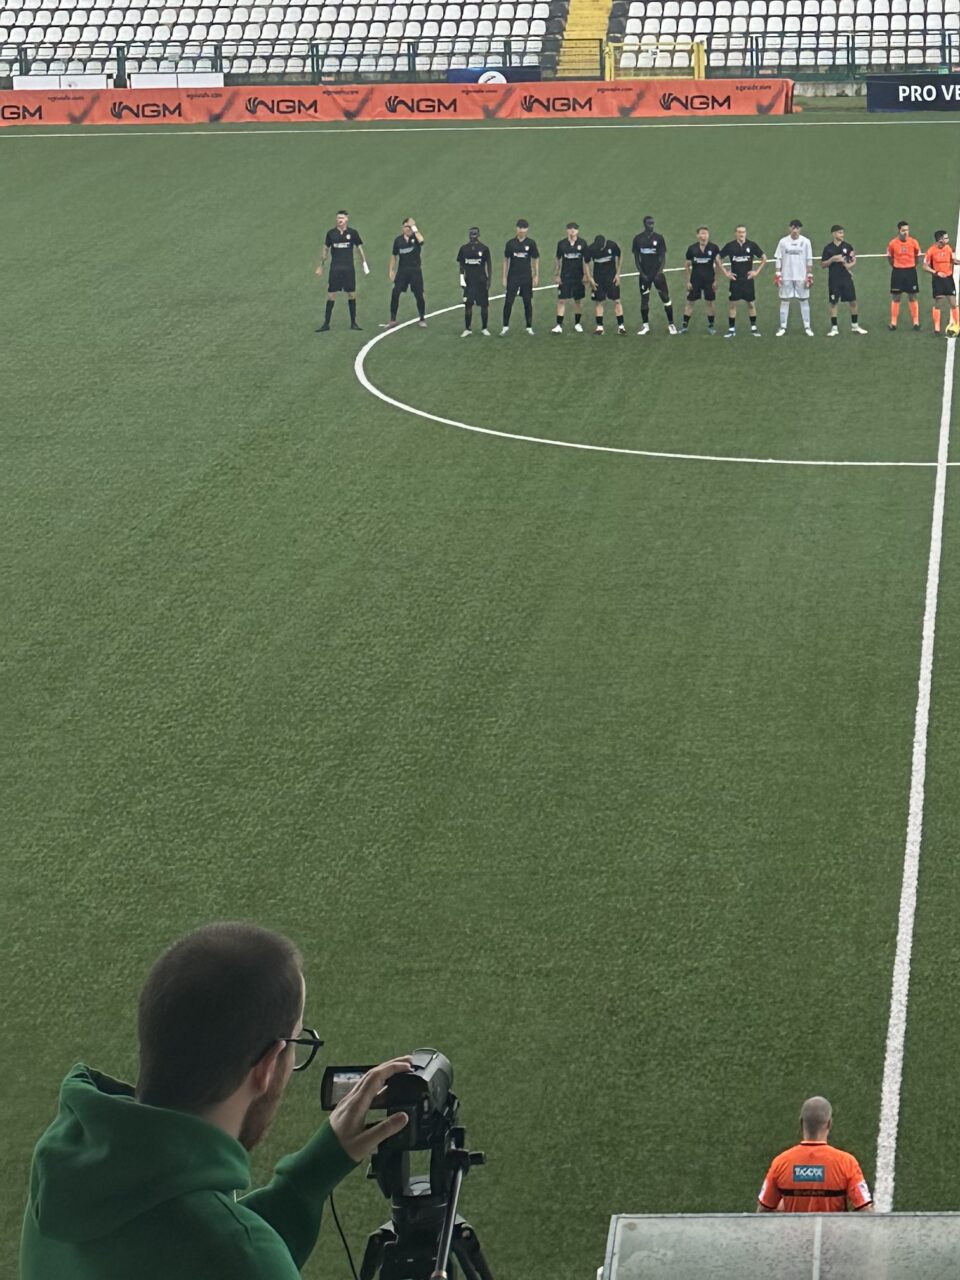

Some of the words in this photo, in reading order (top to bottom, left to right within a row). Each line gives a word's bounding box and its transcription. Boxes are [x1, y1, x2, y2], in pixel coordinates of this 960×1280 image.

[659, 92, 731, 110] NGM
[898, 85, 937, 102] PRO
[110, 101, 182, 119] NGM
[245, 96, 318, 114] NGM
[385, 95, 457, 113] NGM
[520, 94, 593, 112] NGM
